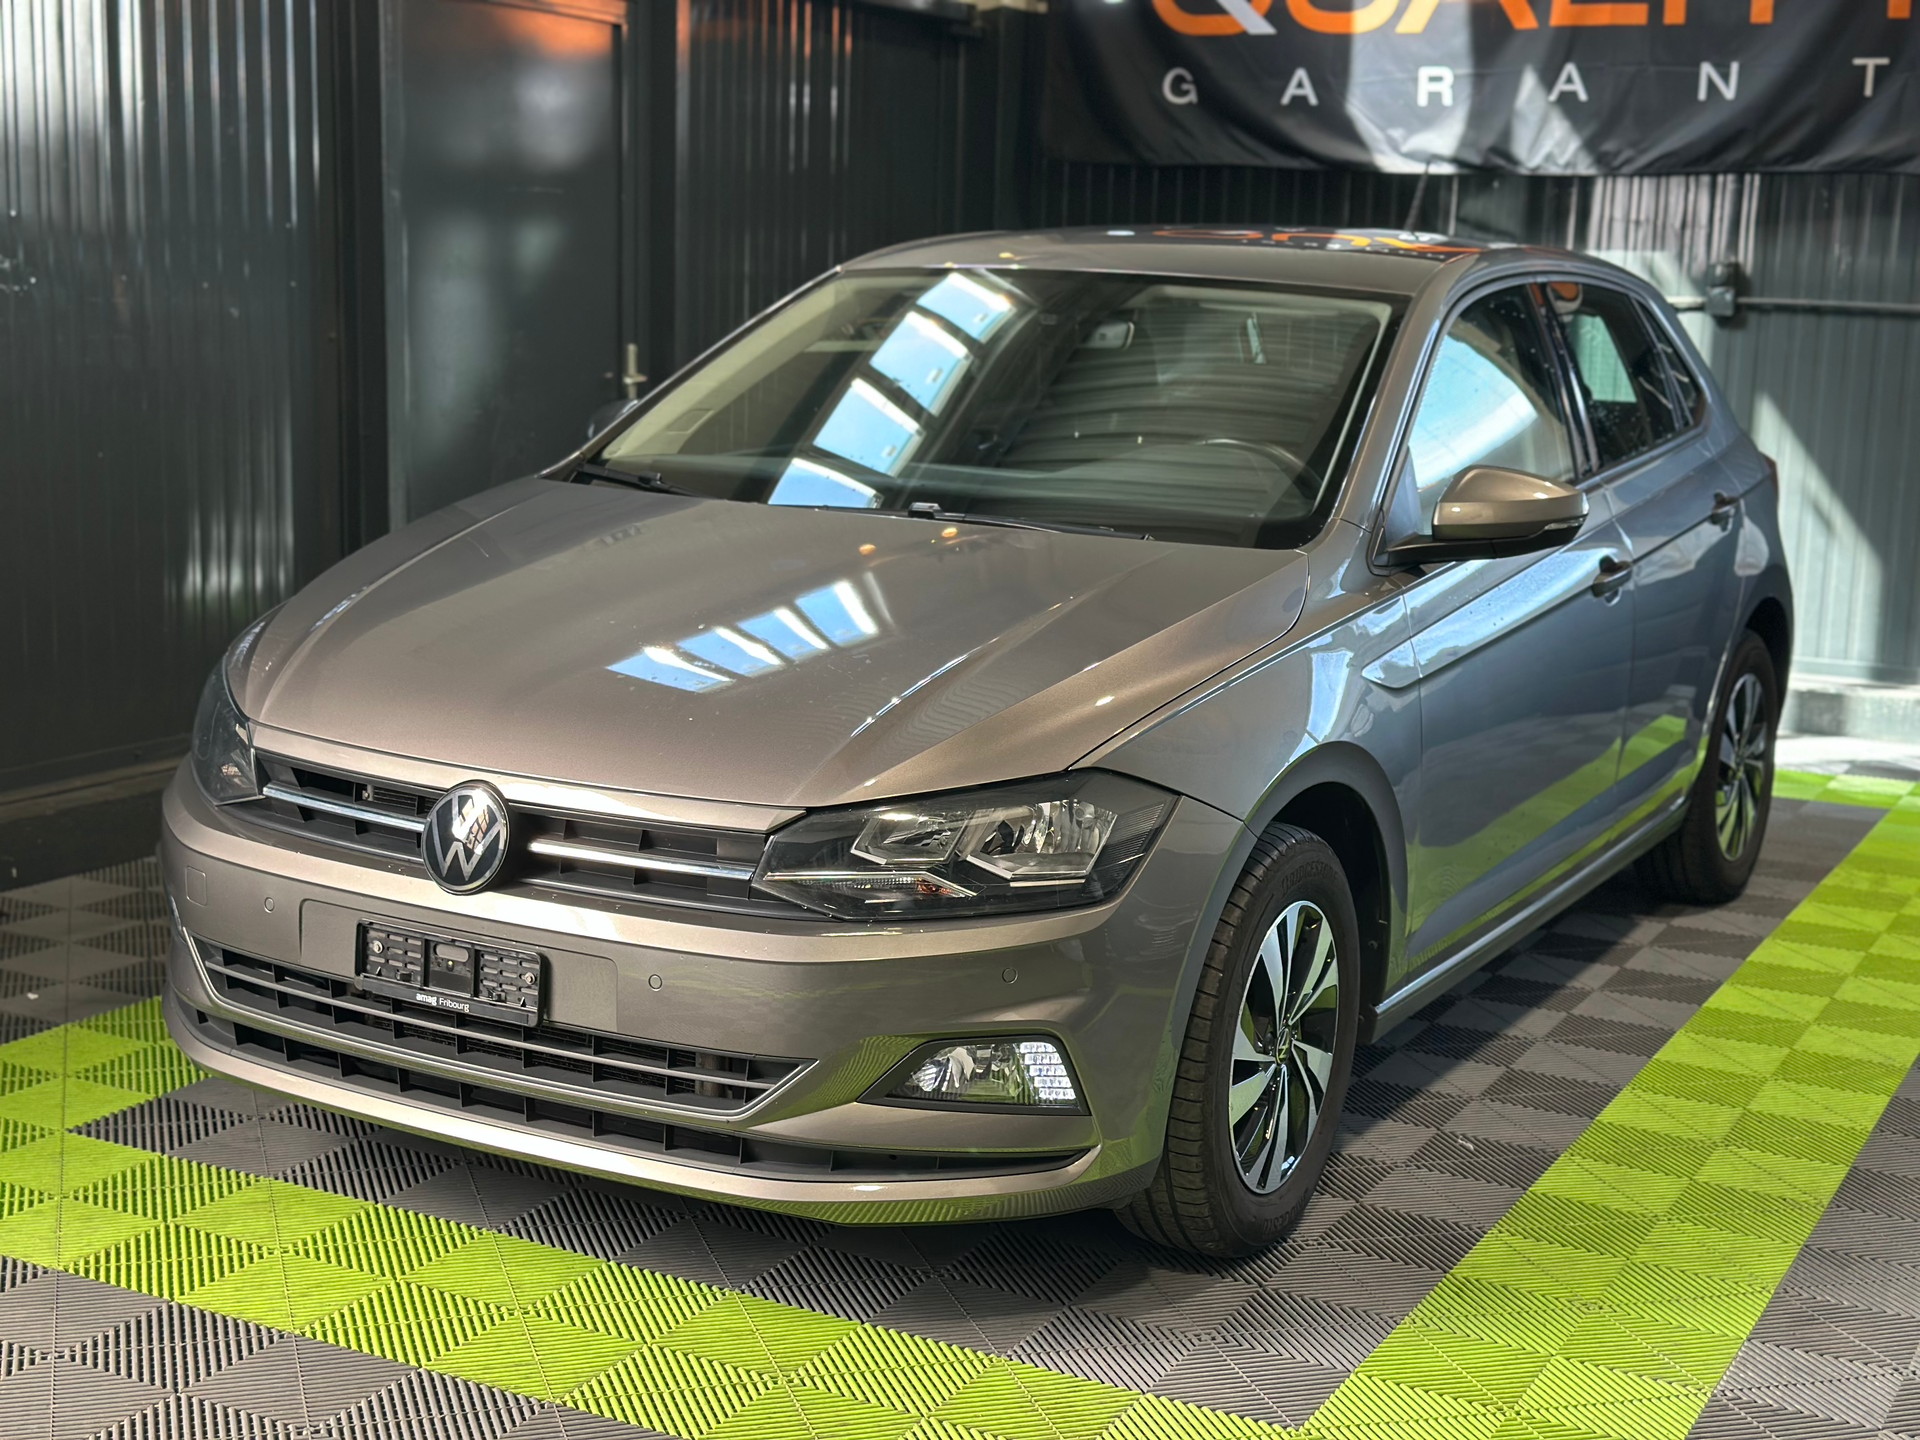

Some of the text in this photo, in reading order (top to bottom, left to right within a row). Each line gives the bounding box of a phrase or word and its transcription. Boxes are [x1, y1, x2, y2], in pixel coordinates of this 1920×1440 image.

[1161, 57, 1891, 107] GARANT
[427, 785, 506, 889] VW
[415, 992, 470, 1013] amag Fribourg
